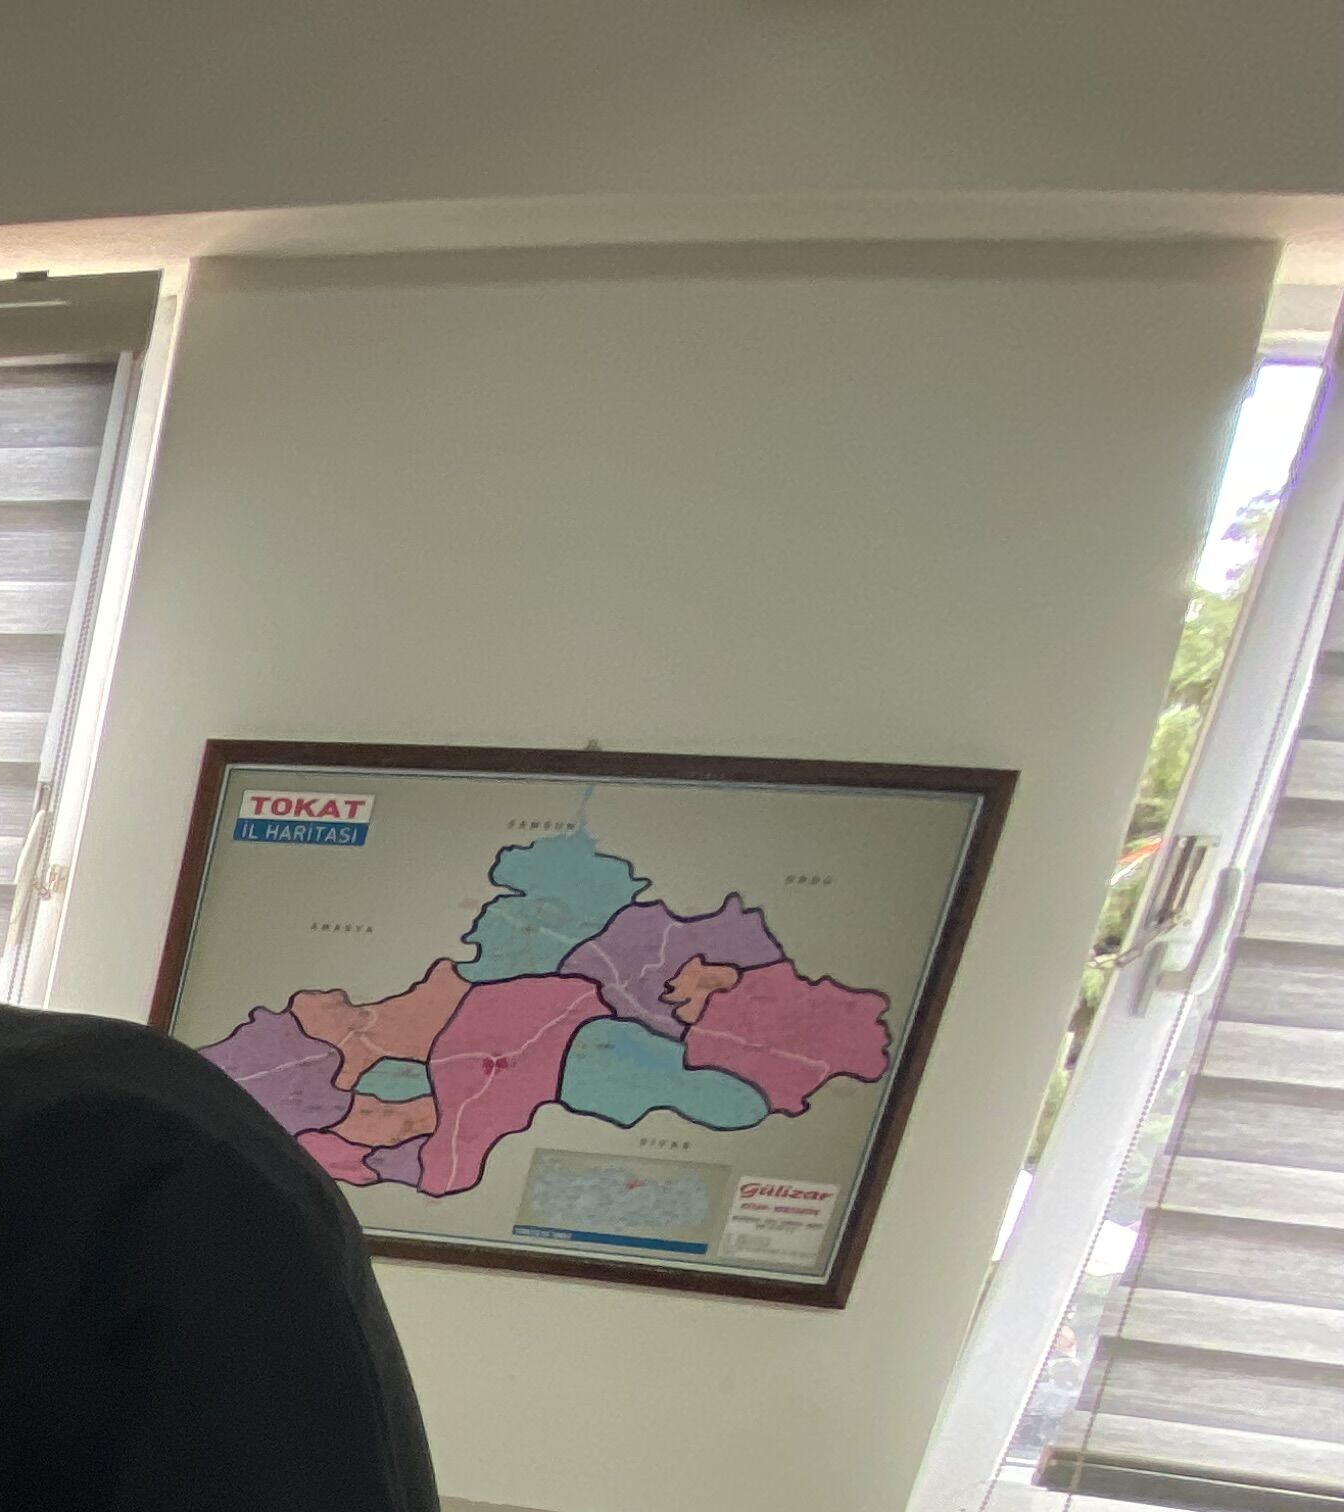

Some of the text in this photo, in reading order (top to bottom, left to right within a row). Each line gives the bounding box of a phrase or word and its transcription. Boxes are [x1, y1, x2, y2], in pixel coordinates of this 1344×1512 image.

[249, 796, 366, 819] TOKAT
[241, 822, 358, 844] İL HARİTASI
